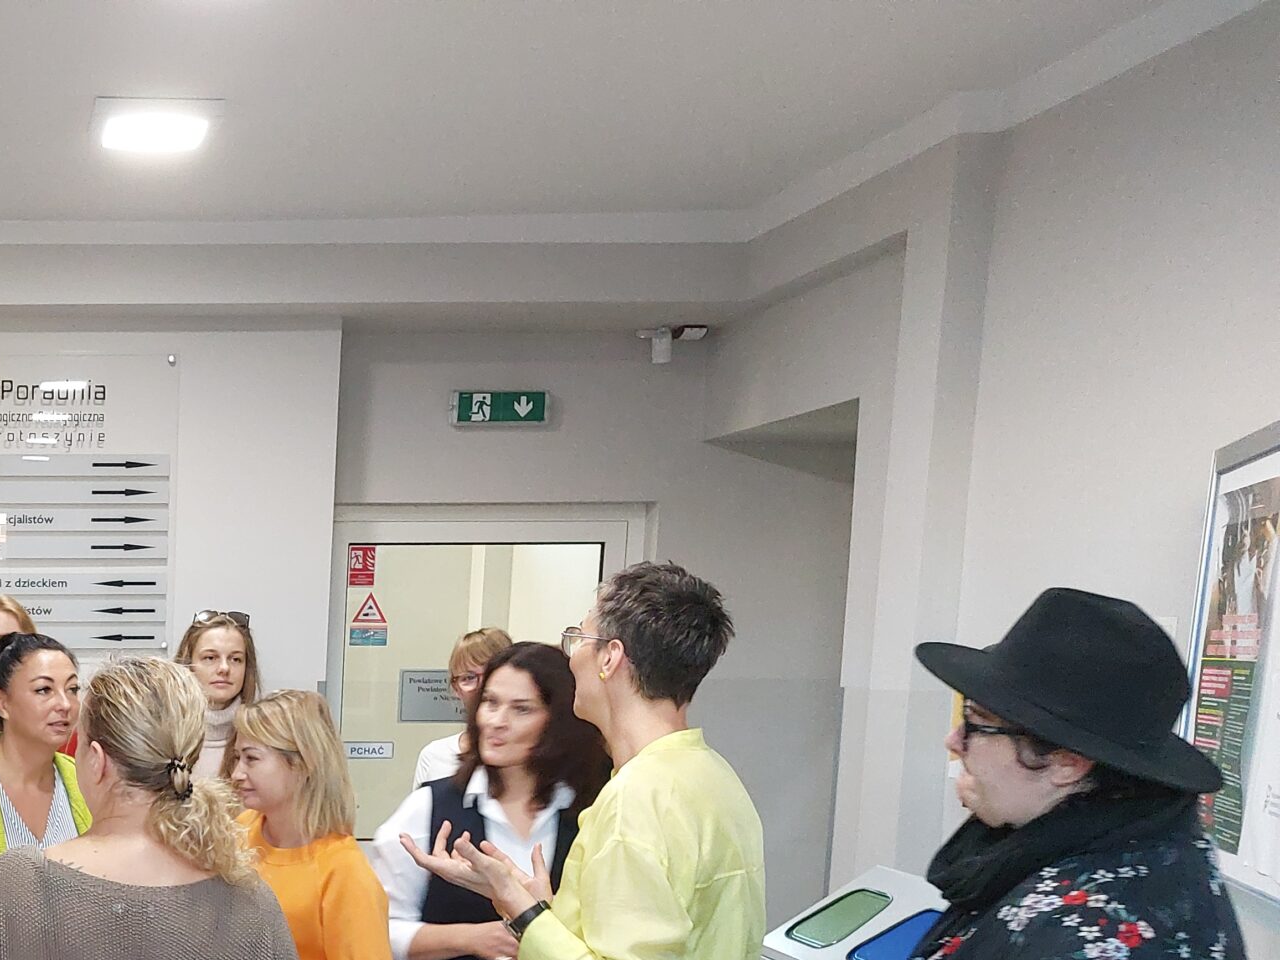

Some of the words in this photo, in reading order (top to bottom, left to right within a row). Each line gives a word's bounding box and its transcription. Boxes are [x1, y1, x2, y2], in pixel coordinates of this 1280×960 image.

[6, 514, 54, 527] cjalistów
[5, 580, 11, 588] z
[14, 577, 68, 588] dzieckiem
[350, 744, 384, 755] PCHAĆ
